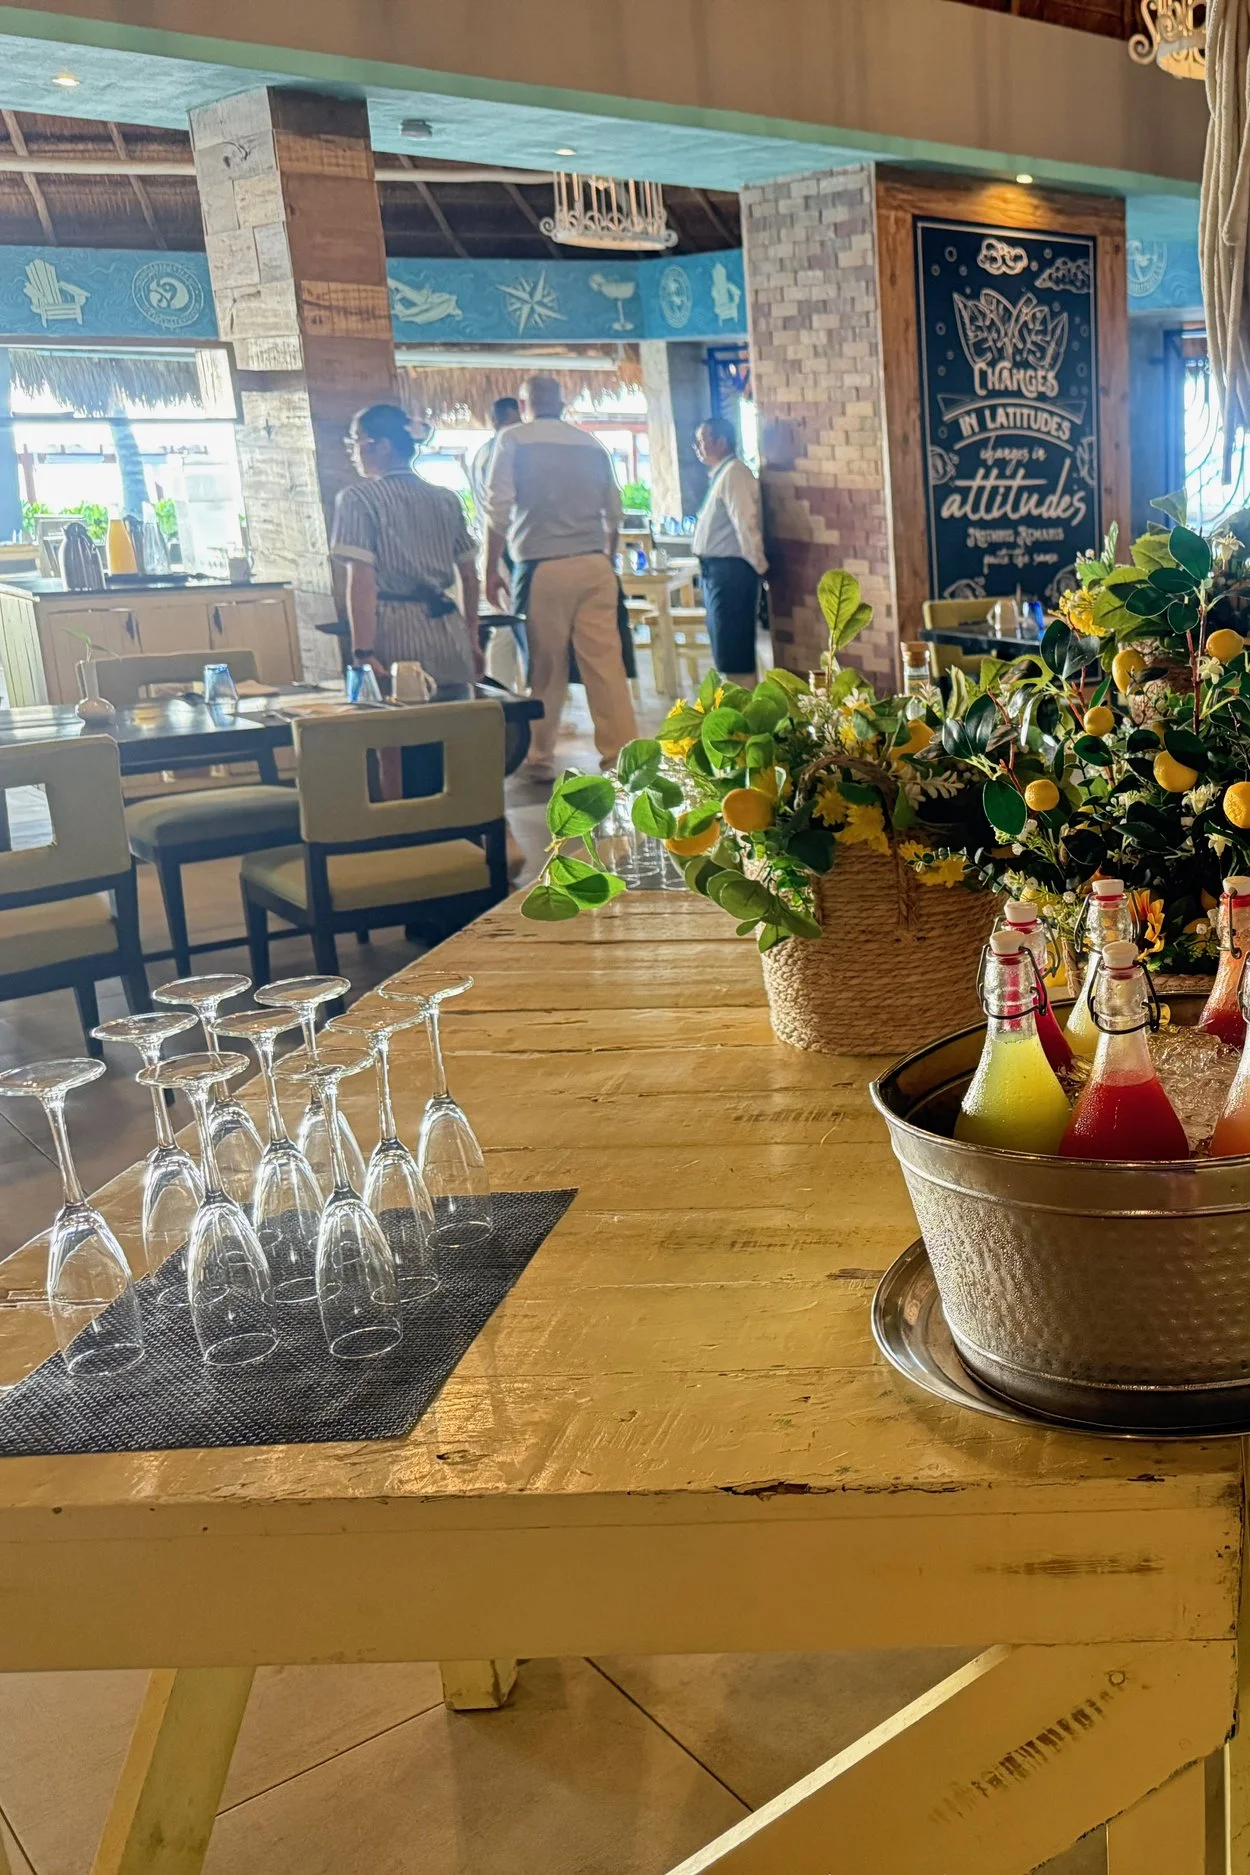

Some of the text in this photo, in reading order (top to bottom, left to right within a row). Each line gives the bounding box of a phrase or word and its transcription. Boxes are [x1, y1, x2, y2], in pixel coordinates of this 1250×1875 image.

[973, 360, 1060, 398] CHANGES
[958, 405, 1072, 441] IN LATITUDES
[940, 457, 1087, 527] attitudes
